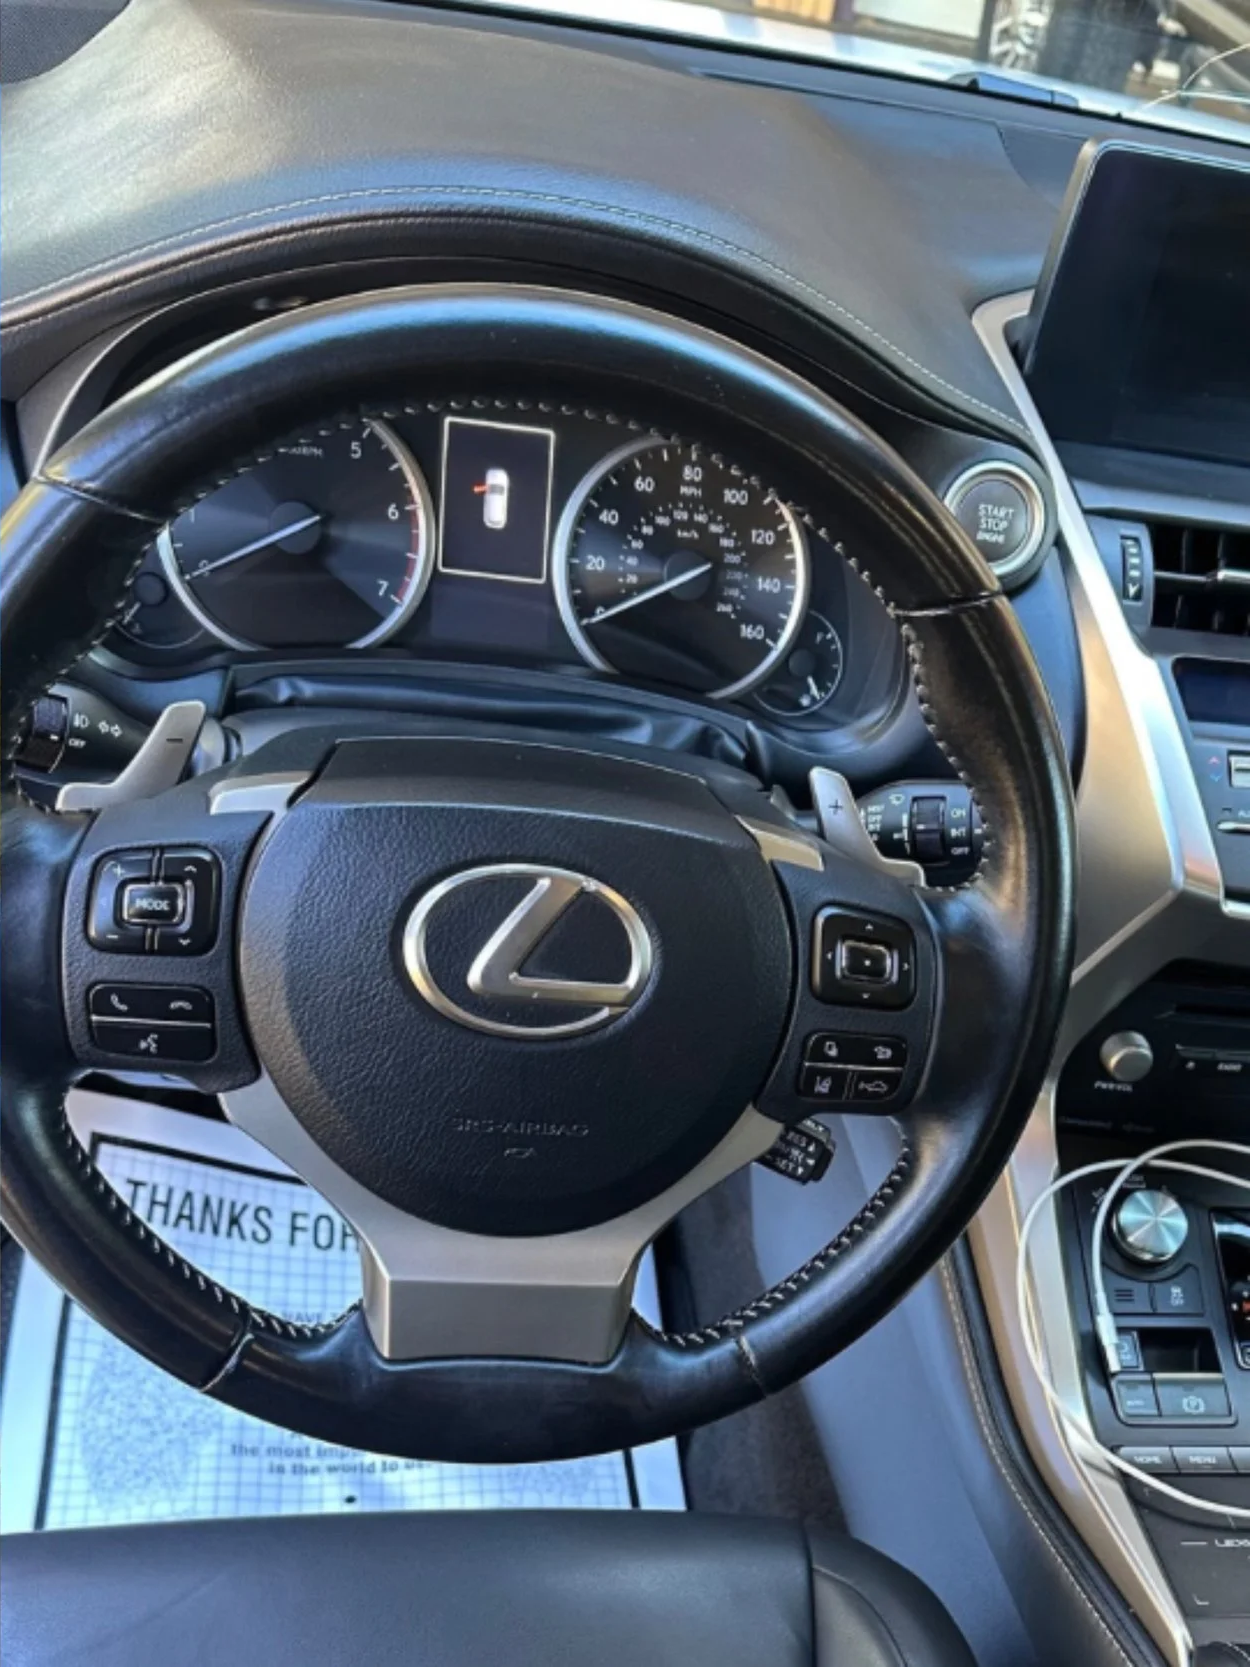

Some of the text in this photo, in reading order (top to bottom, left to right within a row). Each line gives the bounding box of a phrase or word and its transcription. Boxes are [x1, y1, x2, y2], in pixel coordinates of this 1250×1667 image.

[351, 442, 362, 459] 5
[683, 466, 703, 481] 80
[634, 477, 655, 492] 60
[680, 485, 702, 498] MPH
[723, 488, 748, 506] 100
[388, 505, 399, 520] 6
[599, 509, 619, 525] 40
[978, 503, 1014, 519] START
[979, 516, 1008, 531] STOP
[751, 529, 774, 546] 120
[586, 555, 605, 571] 20
[377, 580, 389, 597] 7
[757, 577, 781, 592] 140
[740, 624, 765, 639] 160
[69, 738, 86, 748] OFF
[950, 808, 965, 818] ON
[950, 847, 969, 855] OFF
[136, 898, 170, 911] MODE
[126, 1178, 272, 1245] THANKS
[231, 1444, 260, 1457] the
[266, 1445, 312, 1458] most
[1189, 1455, 1218, 1464] MENU
[291, 1462, 320, 1475] the
[325, 1460, 375, 1474] world
